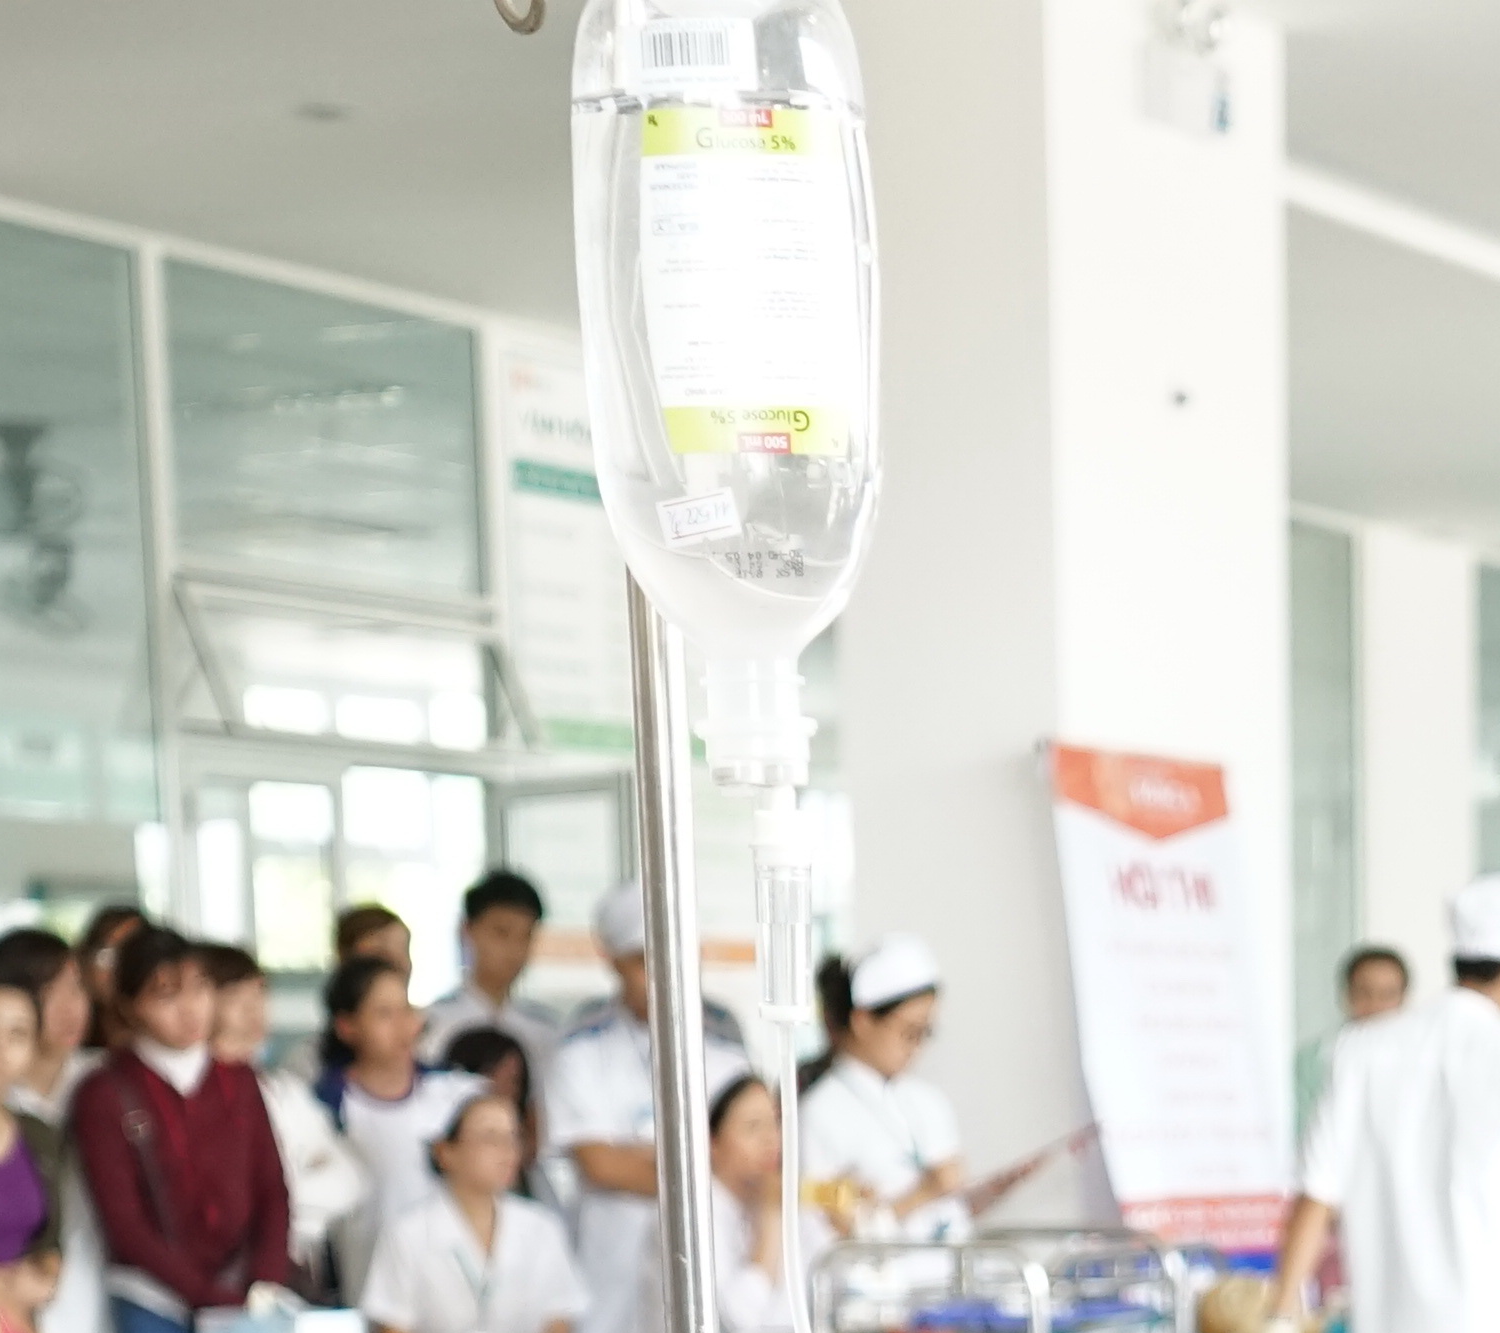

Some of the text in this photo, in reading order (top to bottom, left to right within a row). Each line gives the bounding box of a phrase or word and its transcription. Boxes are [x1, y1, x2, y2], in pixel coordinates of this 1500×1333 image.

[695, 126, 797, 153] Glucose 5%
[710, 409, 810, 432] Glucose 5%
[740, 435, 788, 448] 500 mL
